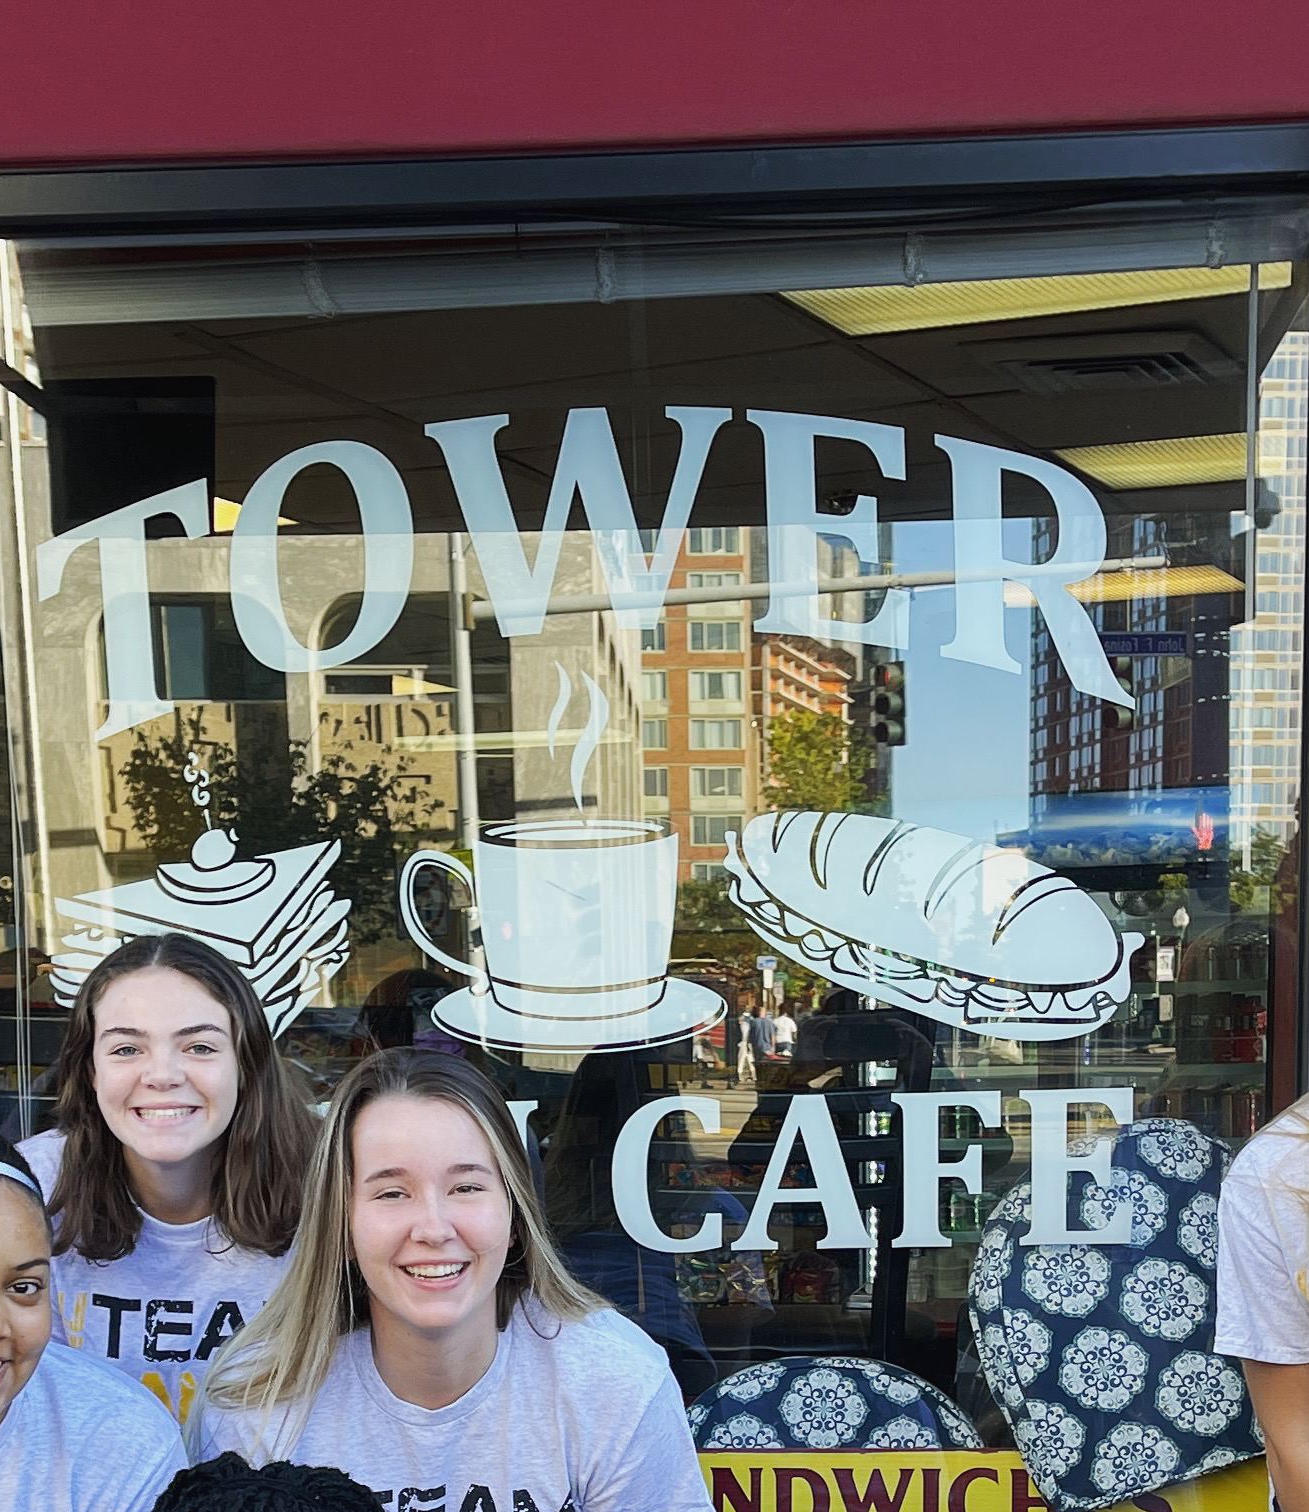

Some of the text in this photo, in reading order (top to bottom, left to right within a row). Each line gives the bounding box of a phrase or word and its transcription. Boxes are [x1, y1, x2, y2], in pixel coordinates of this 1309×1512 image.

[36, 404, 1136, 740] TOWER
[610, 1086, 1135, 1254] CAFE
[92, 1293, 248, 1363] TEA
